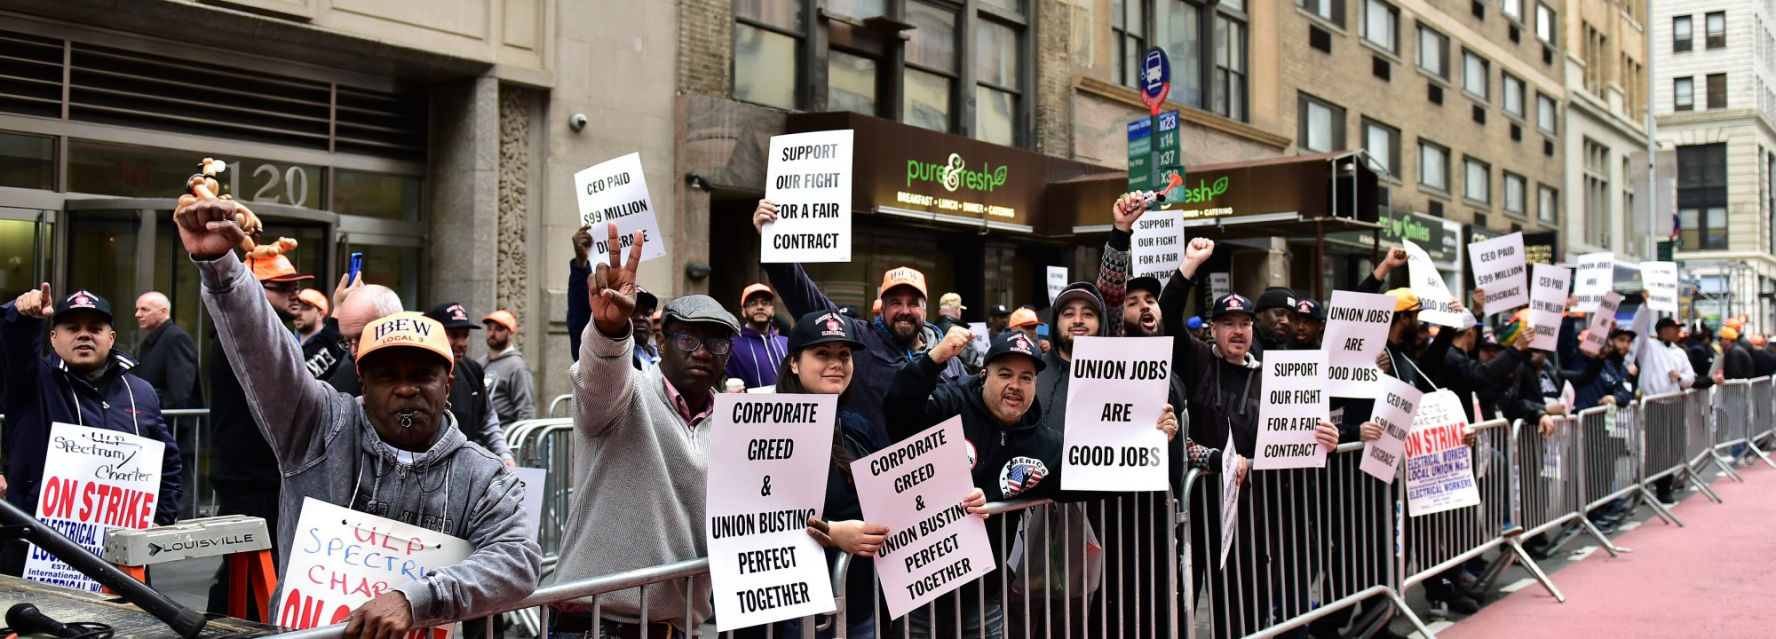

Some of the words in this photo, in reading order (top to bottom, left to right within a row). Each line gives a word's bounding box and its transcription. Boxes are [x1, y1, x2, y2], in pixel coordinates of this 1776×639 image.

[1160, 115, 1176, 132] M23
[782, 144, 838, 162] SUPPORT
[228, 161, 308, 208] 120
[587, 178, 605, 196] CEO
[606, 172, 631, 188] PAID
[776, 174, 801, 190] OUR
[804, 172, 840, 188] FIGHT
[584, 210, 602, 226] $99
[604, 199, 648, 220] MILLION
[775, 204, 798, 218] FOR
[801, 204, 809, 218] A
[812, 202, 839, 218] FAIR
[897, 192, 933, 206] BREAKFAST
[938, 198, 958, 210] LUNCH
[962, 202, 984, 214] DINNER
[988, 205, 1016, 218] CATERING
[1204, 207, 1233, 216] CATERING
[1140, 218, 1174, 230] SUPPORT
[596, 230, 650, 254] DIRAE
[773, 233, 839, 250] CONTRACT
[1138, 238, 1154, 247] OUR
[1156, 236, 1177, 246] FIGHT
[1139, 256, 1154, 264] FOR
[1156, 254, 1160, 263] A
[1162, 253, 1178, 262] FAIR
[1480, 250, 1496, 262] CEO
[1498, 246, 1515, 258] PAID
[1478, 274, 1493, 285] $99
[1494, 266, 1523, 280] MILLION
[1540, 276, 1551, 287] CEO
[1552, 279, 1564, 290] PAID
[1486, 286, 1520, 303] DISGRACE
[1330, 306, 1364, 322] UNION
[1364, 307, 1391, 324] JOBS
[1545, 302, 1564, 314] MILLION
[374, 318, 432, 342] IBEW
[382, 334, 416, 344] LOCAL
[1343, 337, 1365, 352] ARE
[1074, 359, 1126, 380] UNION
[1129, 360, 1168, 381] JOBS
[1274, 362, 1318, 377] SUPPORT
[1328, 366, 1348, 380] OOD
[1351, 366, 1378, 382] JOBS
[1270, 392, 1291, 405] OUR
[1294, 390, 1321, 404] FIGHT
[1387, 392, 1400, 408] CEO
[1400, 399, 1414, 414] PAID
[732, 402, 818, 424] CORPORATE
[1101, 403, 1133, 422] ARE
[1267, 418, 1288, 431] FOR
[1290, 417, 1297, 431] A
[1300, 416, 1321, 431] FAIR
[1387, 421, 1407, 441] MILLION
[748, 438, 794, 460] GREED
[1264, 443, 1318, 458] CONTRACT
[1405, 432, 1422, 458] ON
[1424, 422, 1466, 454] STRIKE
[870, 428, 948, 477] CORPORATE
[1069, 445, 1114, 467] GOOD
[1119, 446, 1161, 467] JOBS
[1370, 445, 1395, 467] DISGRACE
[1408, 454, 1440, 470] ELECTRICAL
[1443, 446, 1468, 462] WORKERS
[95, 464, 152, 482] Charter
[894, 462, 936, 494] GREED
[1408, 468, 1430, 482] LOCAL
[1432, 463, 1454, 476] UNION
[761, 475, 772, 497] &
[1410, 486, 1443, 500] ELECTRICAL
[1444, 479, 1472, 491] WORKERS
[42, 476, 78, 519] ON
[79, 482, 154, 530] STRIKE
[915, 495, 926, 511] &
[40, 518, 97, 545] ECTRICAL
[712, 514, 755, 540] UNION
[162, 534, 254, 553] LOUISVILLE
[354, 523, 424, 556] ULP
[878, 526, 918, 558] UNION
[304, 528, 426, 581] SPECTR
[738, 546, 797, 575] PERFECT
[904, 533, 960, 574] PERFECT
[28, 568, 80, 580] International
[308, 565, 389, 598] CHAR
[906, 557, 972, 601] TOGETHER
[736, 581, 810, 614] TOGETHER
[282, 588, 324, 632] ON
